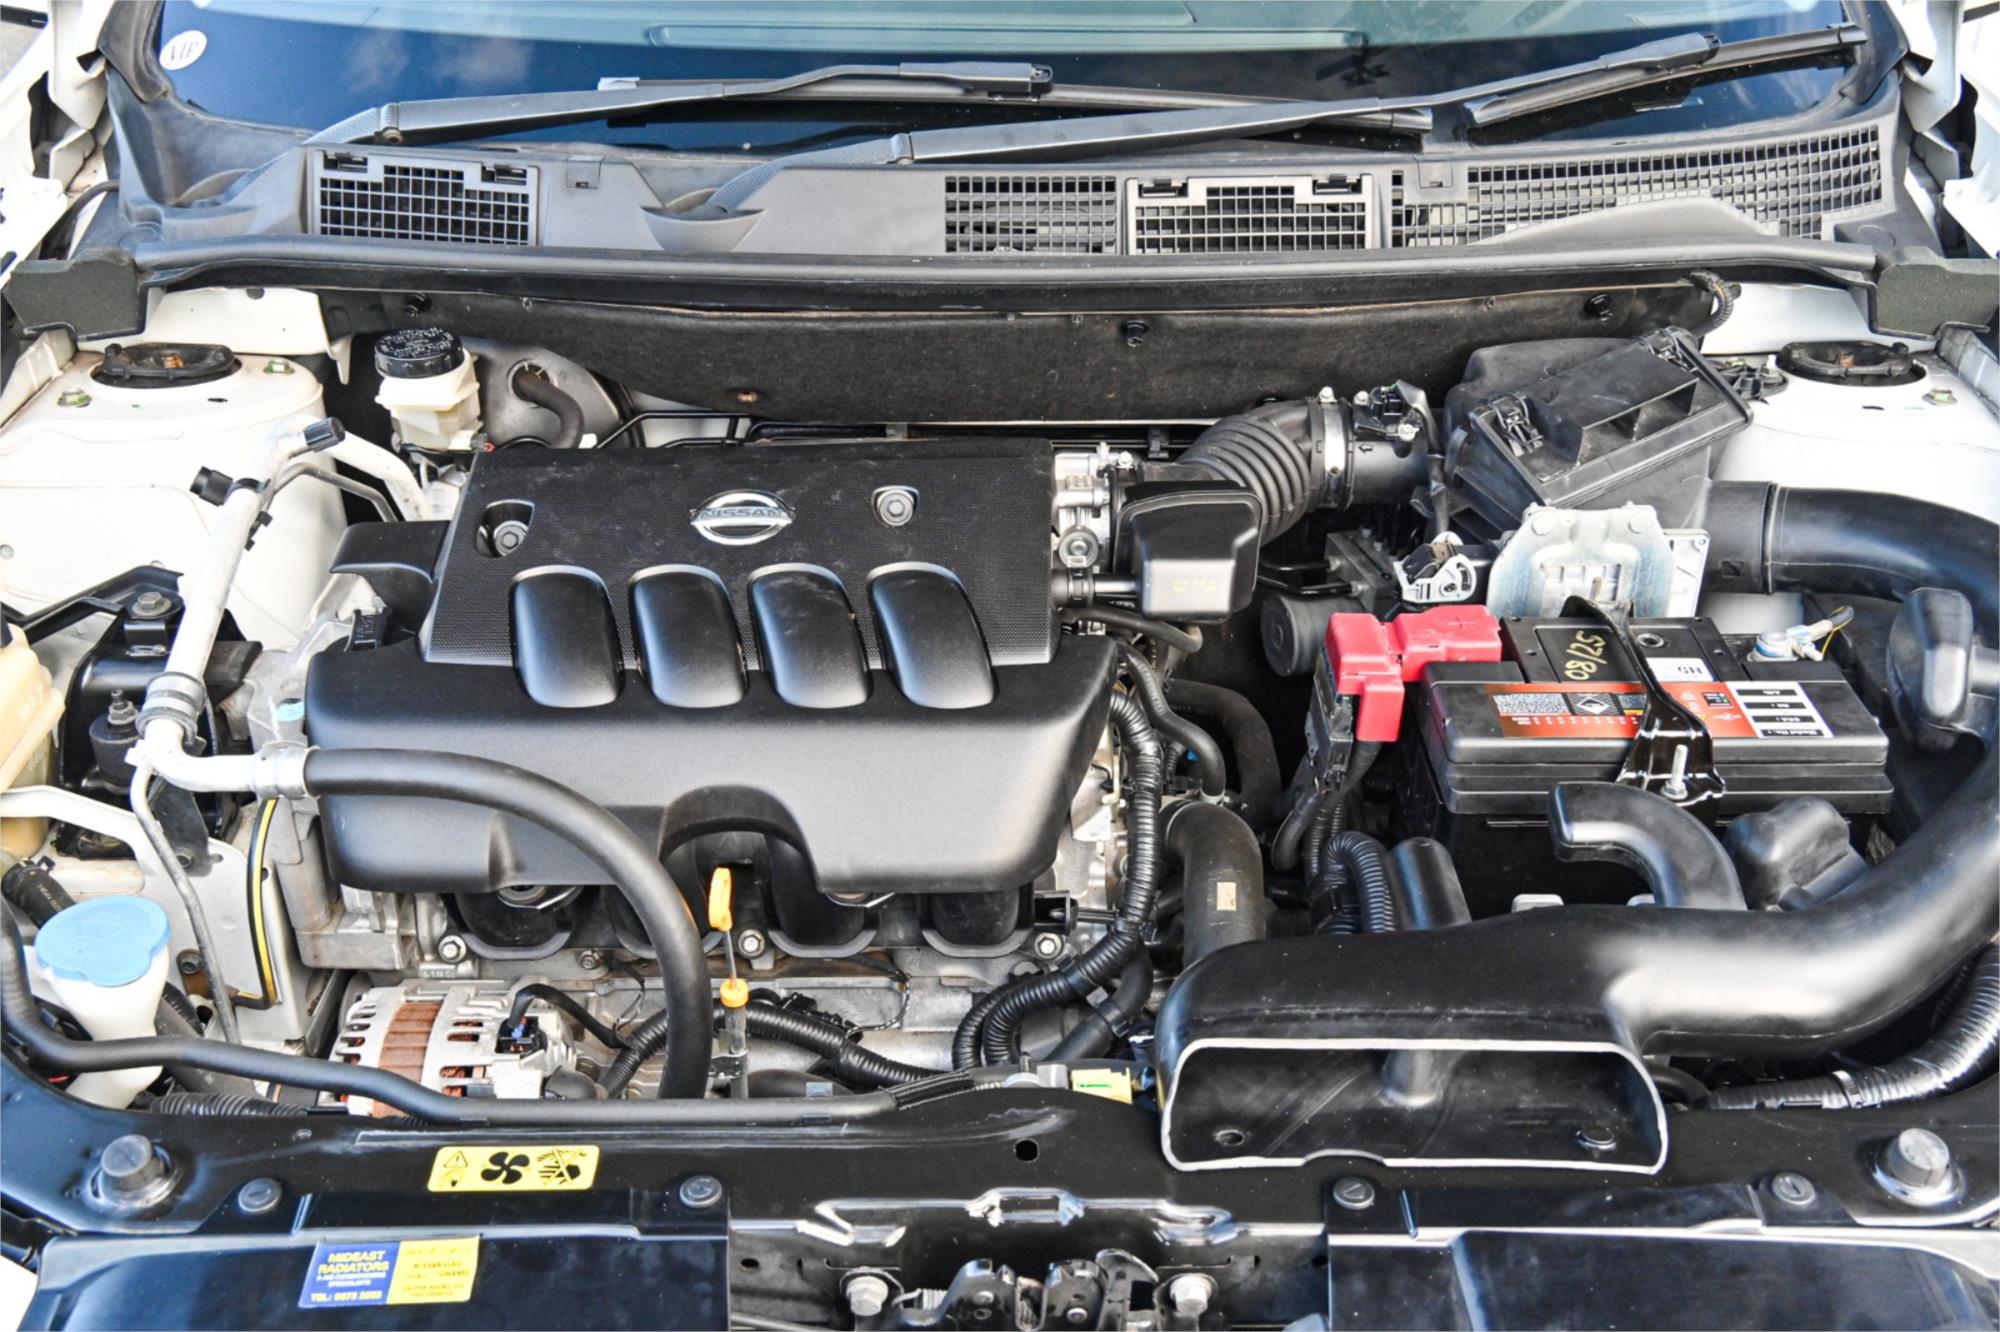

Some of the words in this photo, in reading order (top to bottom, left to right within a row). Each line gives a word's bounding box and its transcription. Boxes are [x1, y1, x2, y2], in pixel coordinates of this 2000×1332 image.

[700, 508, 783, 519] NISSAN
[1564, 630, 1607, 680] 08/25
[328, 1251, 386, 1262] MIDEAST
[318, 1261, 389, 1274] RADIATORS
